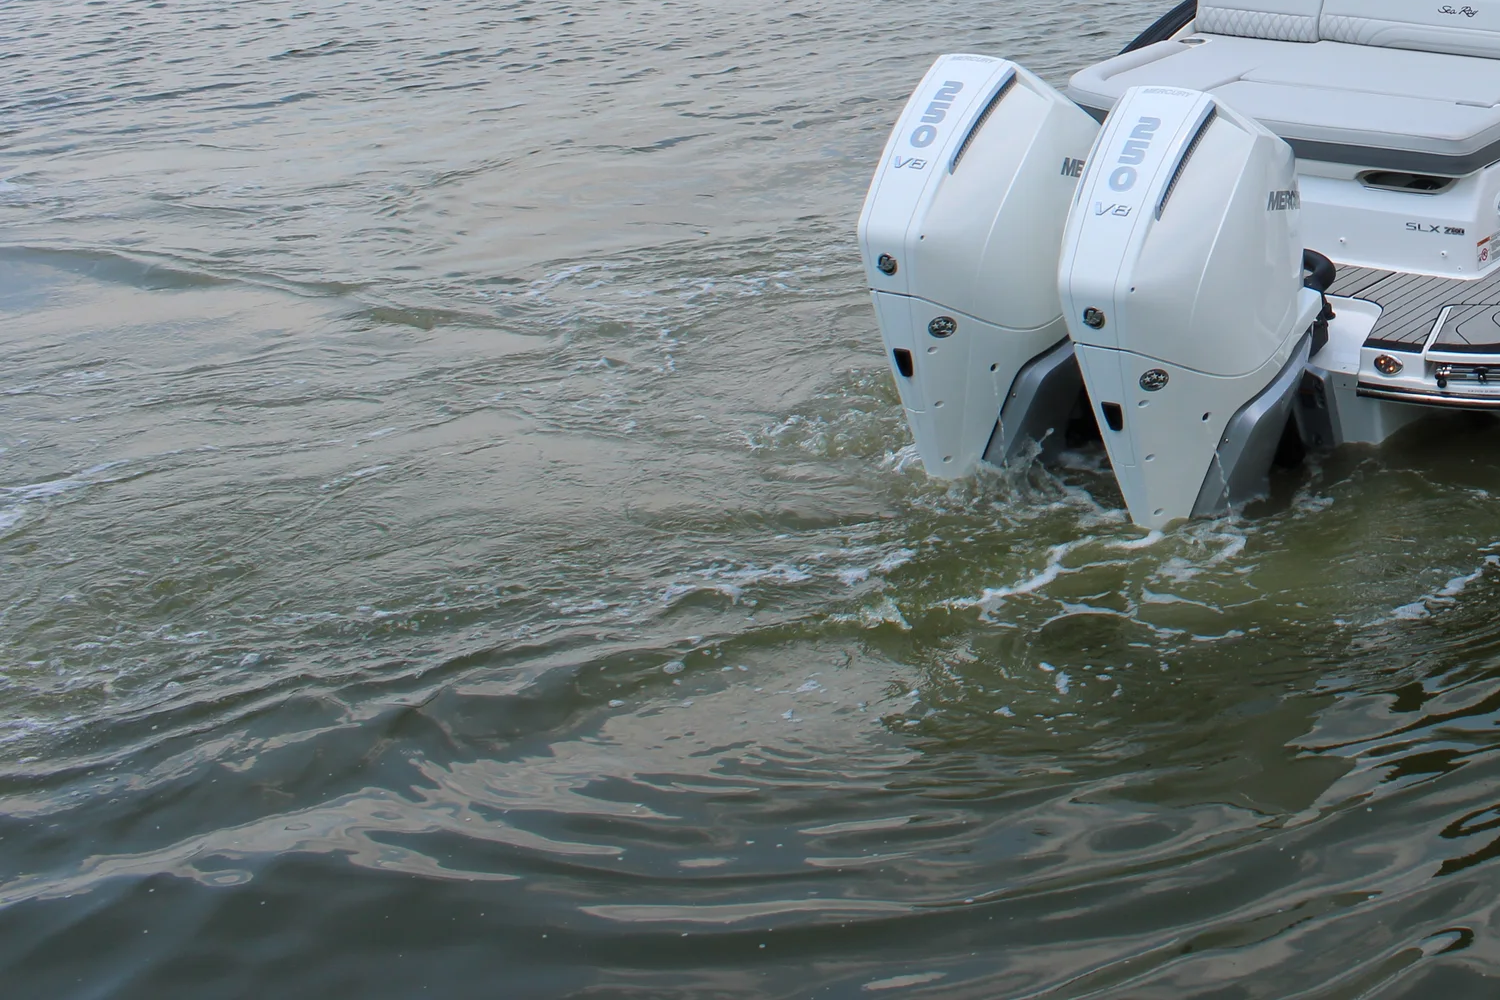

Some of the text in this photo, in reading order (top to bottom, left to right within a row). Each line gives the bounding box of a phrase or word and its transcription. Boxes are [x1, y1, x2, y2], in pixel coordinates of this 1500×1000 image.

[1437, 5, 1479, 18] Sea Ray
[910, 80, 964, 148] 250
[1108, 116, 1162, 192] 250
[894, 155, 928, 170] V8
[1060, 156, 1086, 178] ME
[1095, 201, 1132, 217] V8
[1405, 221, 1440, 234] SLX
